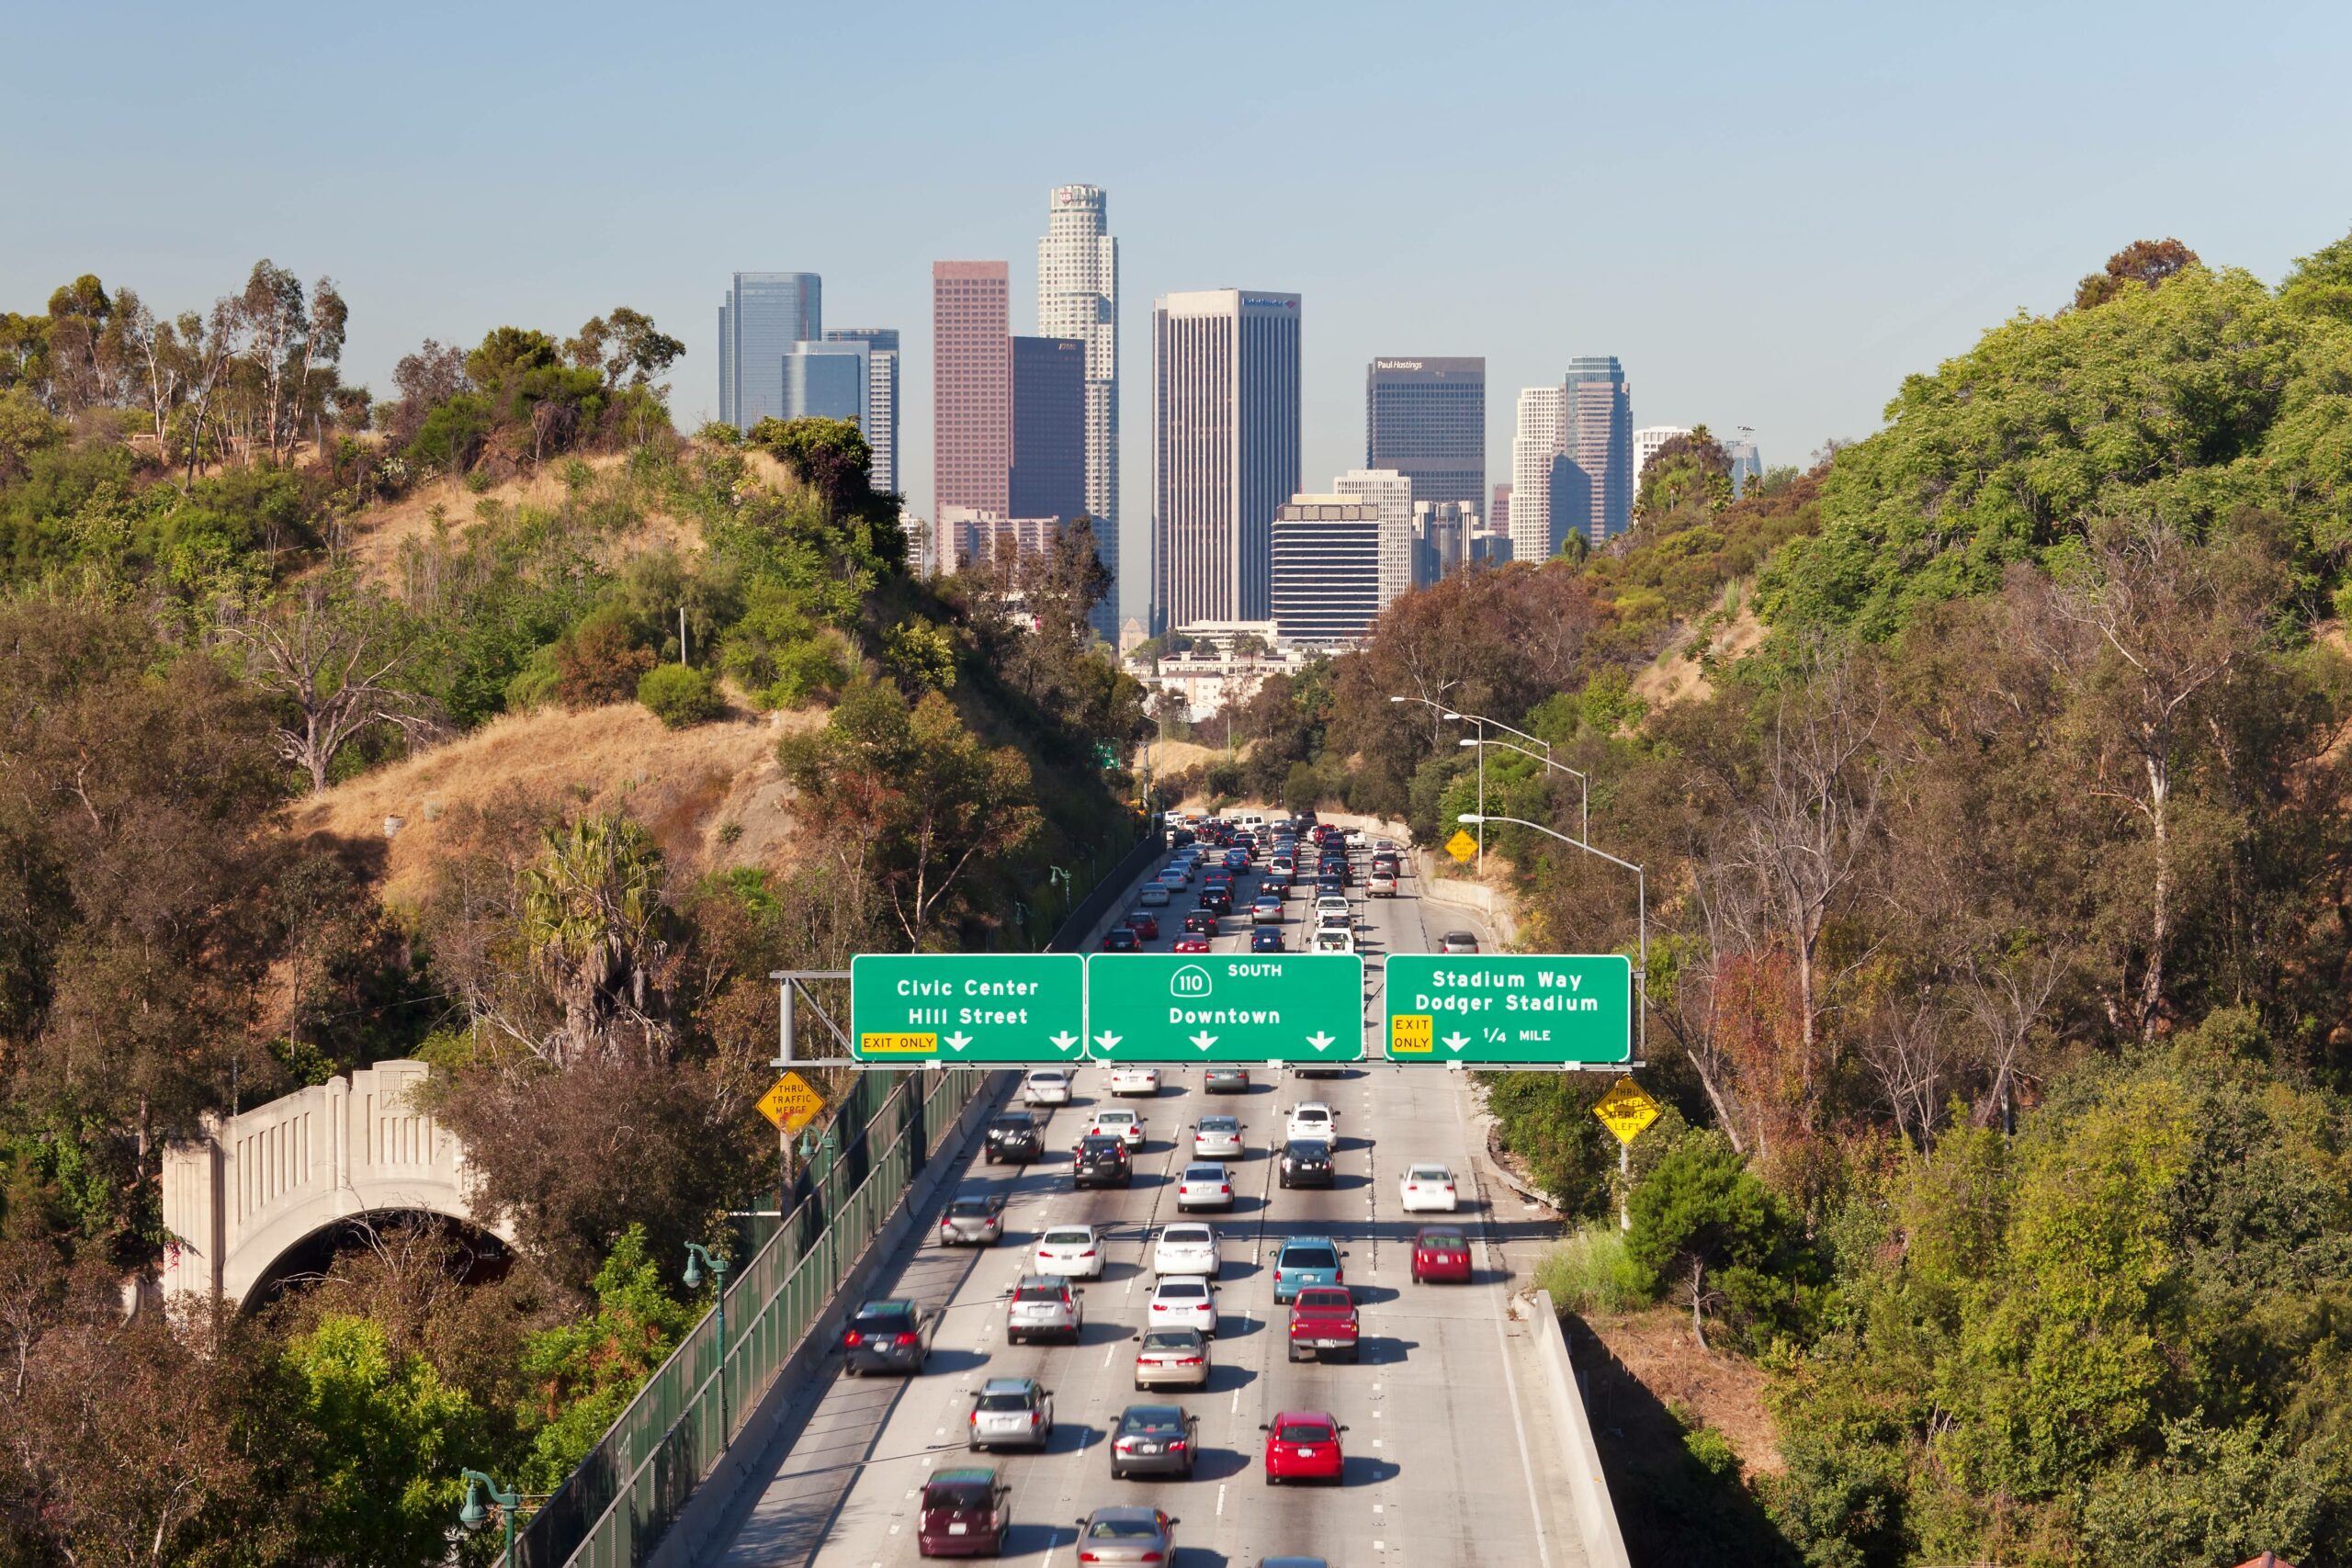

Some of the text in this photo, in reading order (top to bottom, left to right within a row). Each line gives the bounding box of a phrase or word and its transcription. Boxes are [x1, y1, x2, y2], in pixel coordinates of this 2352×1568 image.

[1393, 361, 1422, 370] Hastings
[1228, 964, 1282, 976] SOUTH
[1180, 976, 1203, 991] 110
[1433, 971, 1581, 991] Stadium Way
[898, 979, 1039, 996] Civic Center
[1416, 995, 1598, 1015] Dodger Stadium
[910, 1008, 1028, 1024] Hill Street
[1170, 1008, 1280, 1024] Downtown
[1396, 1020, 1429, 1030] EXIT
[1520, 1030, 1551, 1042] MILE
[864, 1037, 933, 1048] EXIT ONLY
[1395, 1037, 1429, 1048] ONLY
[779, 1085, 804, 1093] THRU
[1615, 1088, 1639, 1097] THRU
[773, 1095, 811, 1104] TRAFFIC
[1608, 1099, 1647, 1108] TRAFFIC
[775, 1106, 807, 1114] MERGE
[1609, 1111, 1645, 1120] MERGE
[1614, 1122, 1641, 1131] LEFT
